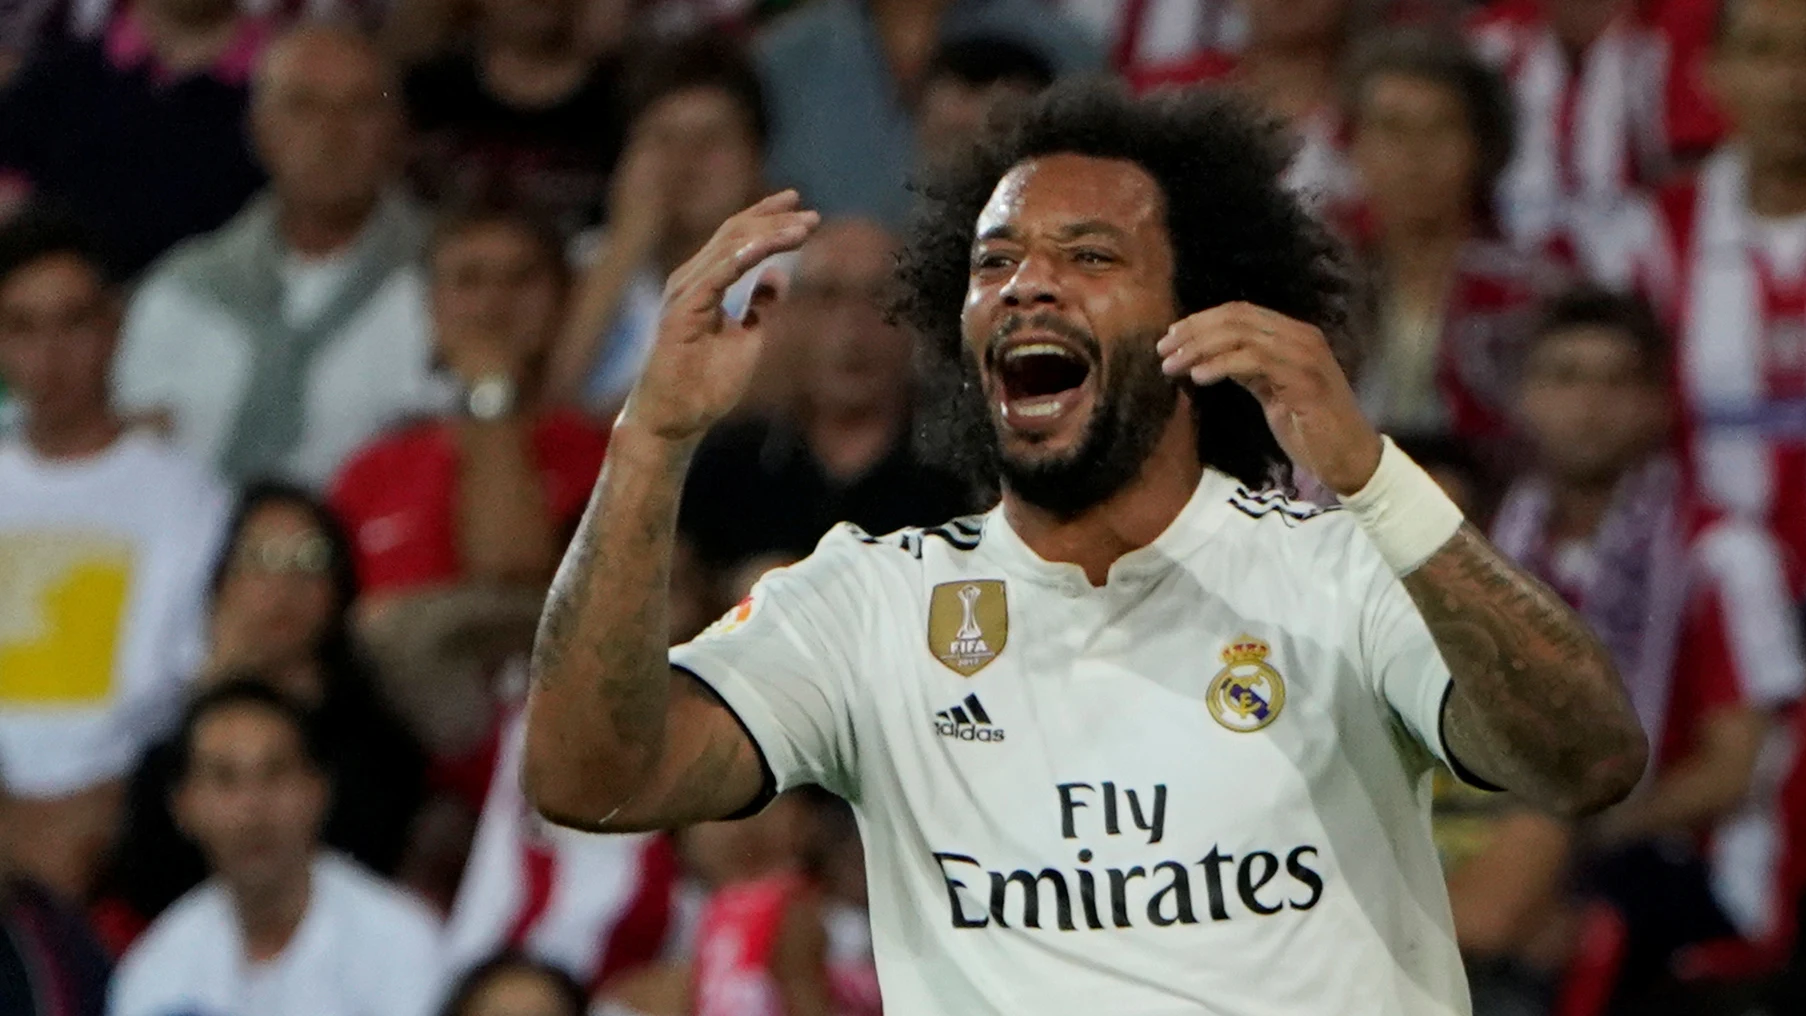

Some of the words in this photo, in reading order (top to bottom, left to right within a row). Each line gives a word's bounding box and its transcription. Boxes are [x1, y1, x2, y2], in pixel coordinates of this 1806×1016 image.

[950, 639, 988, 654] FIFA
[1055, 781, 1167, 844] Fly
[932, 842, 1324, 931] Emirates
